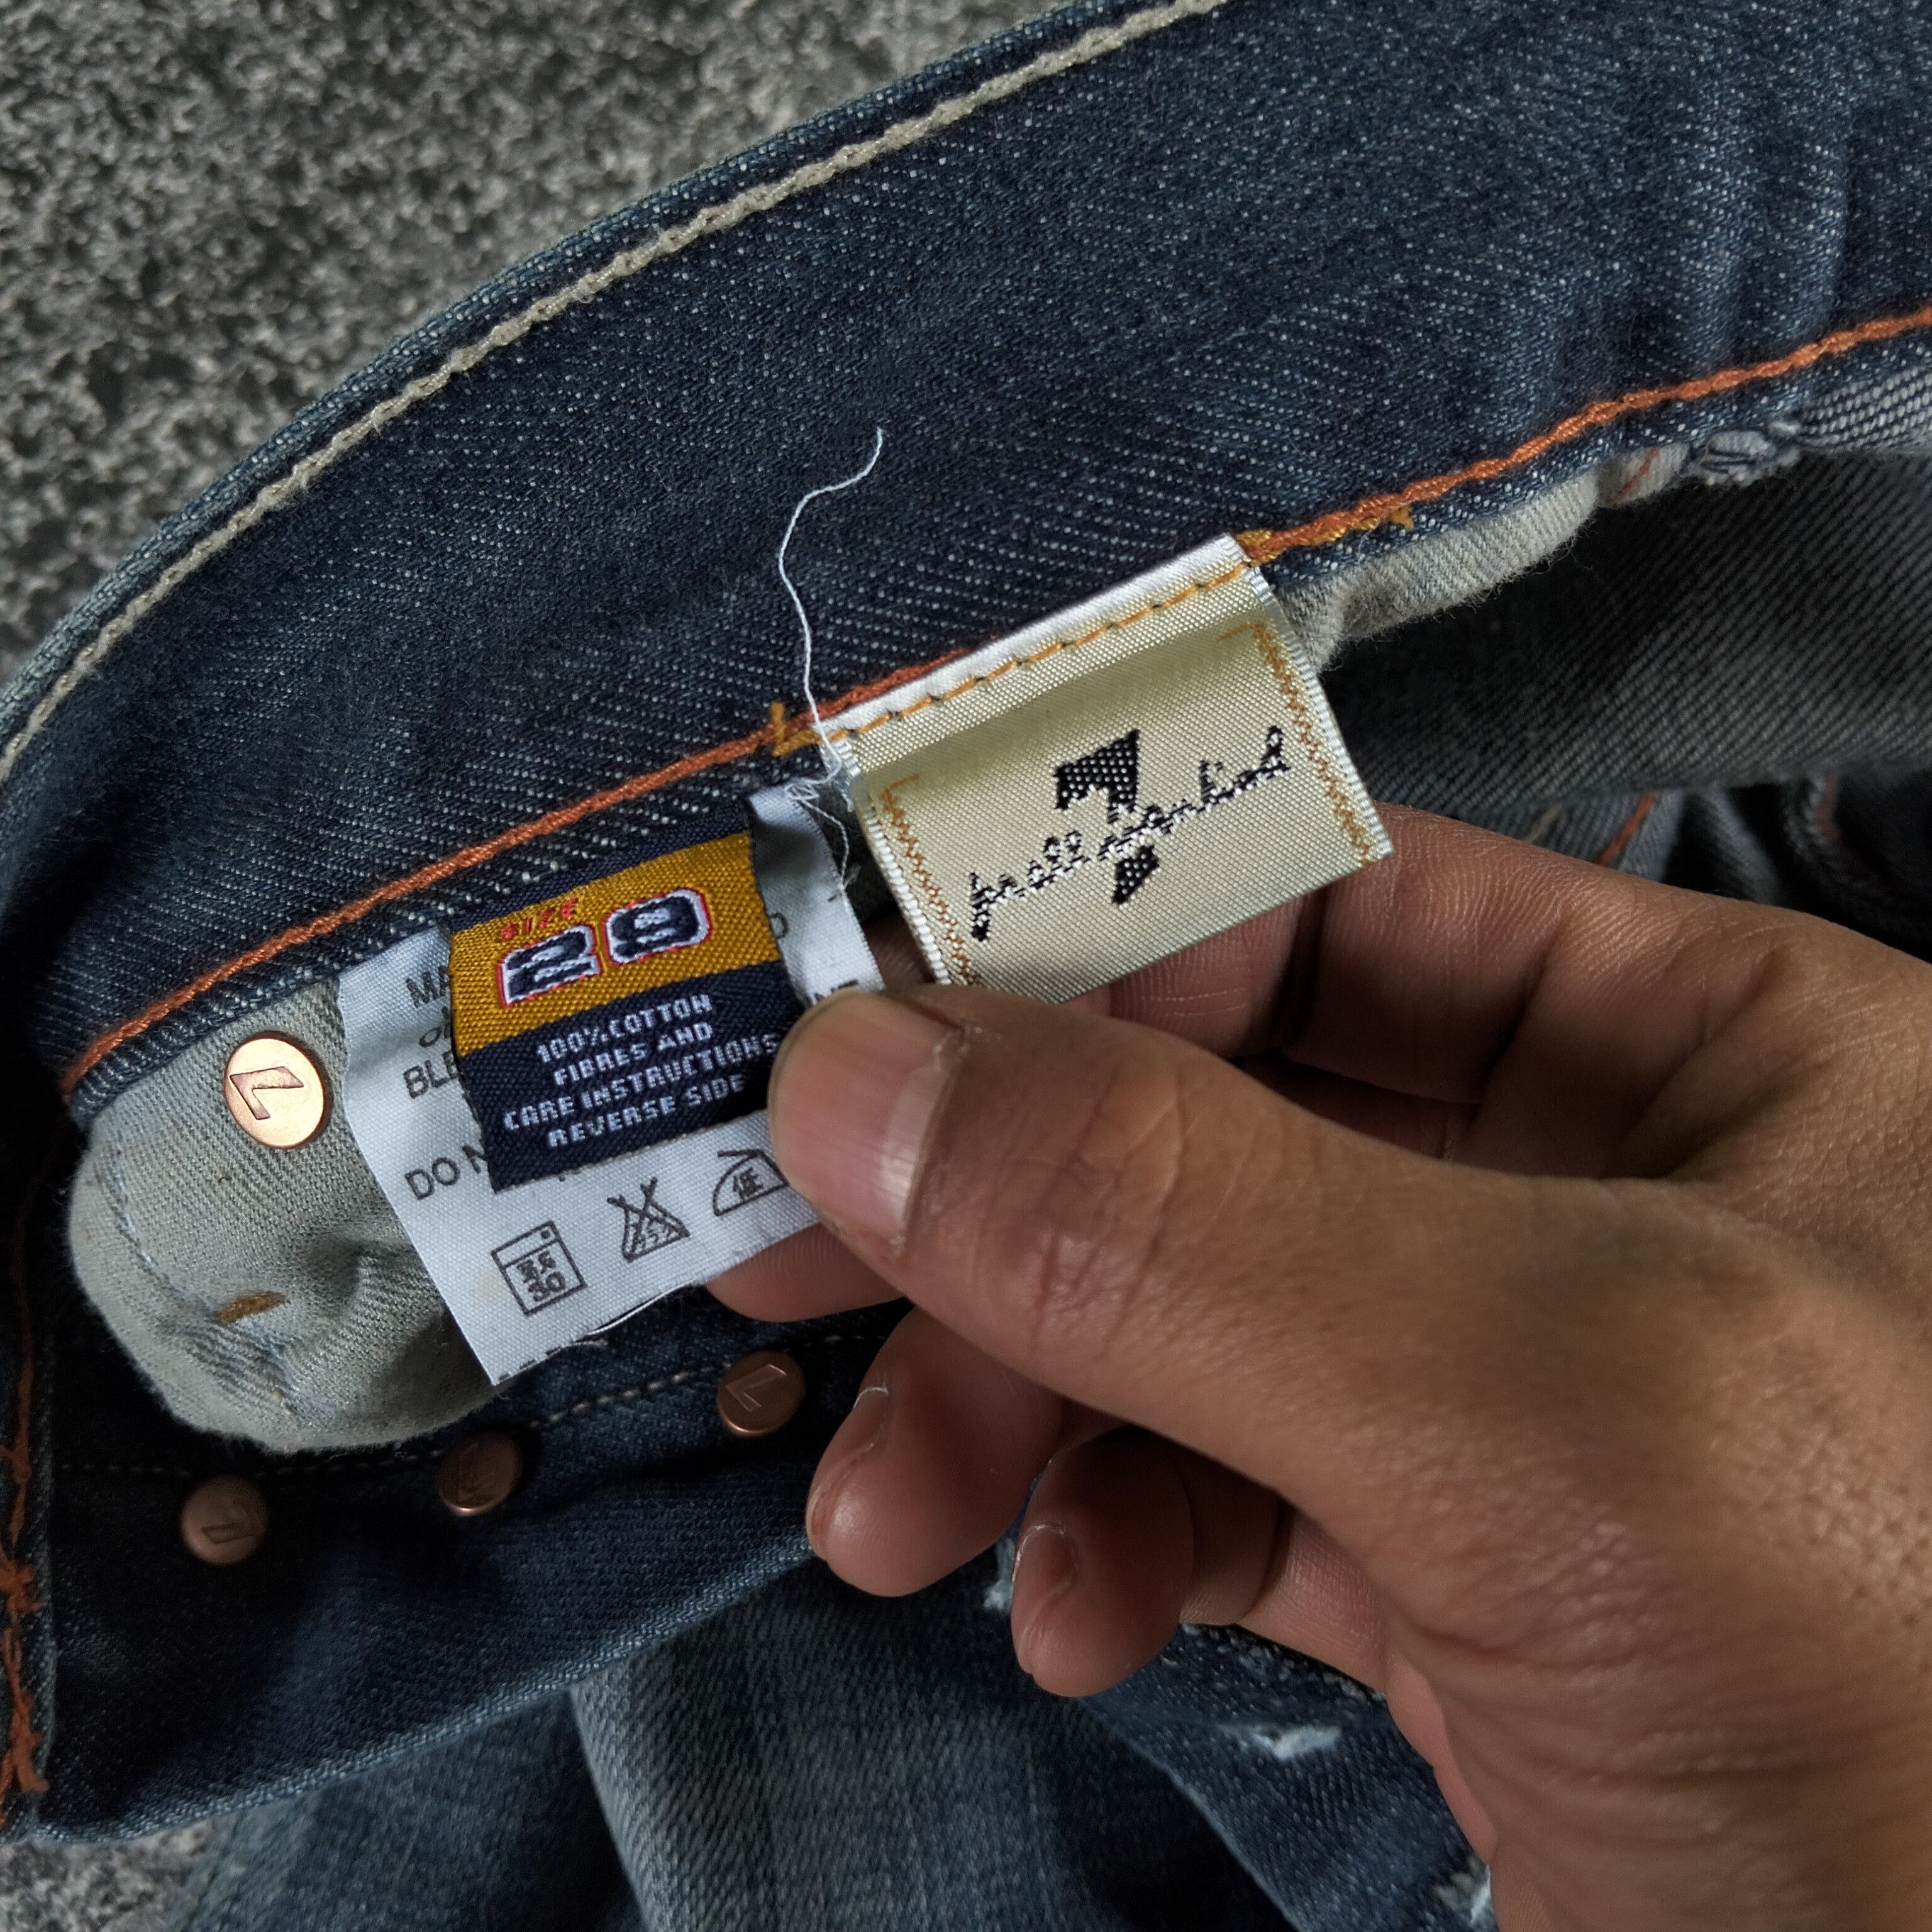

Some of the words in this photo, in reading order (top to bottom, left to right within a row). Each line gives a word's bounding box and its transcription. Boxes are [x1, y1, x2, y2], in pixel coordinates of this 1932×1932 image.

[497, 887, 713, 1006] 29
[500, 898, 578, 942] SIZE
[504, 1095, 575, 1130] CARE
[581, 1033, 780, 1109] INSTRUCTIONS
[553, 1042, 647, 1086] FIBRES
[658, 1022, 713, 1052] AND
[548, 1096, 676, 1148] REVERSE
[686, 1073, 746, 1107] SIDE
[404, 1157, 460, 1200] DO
